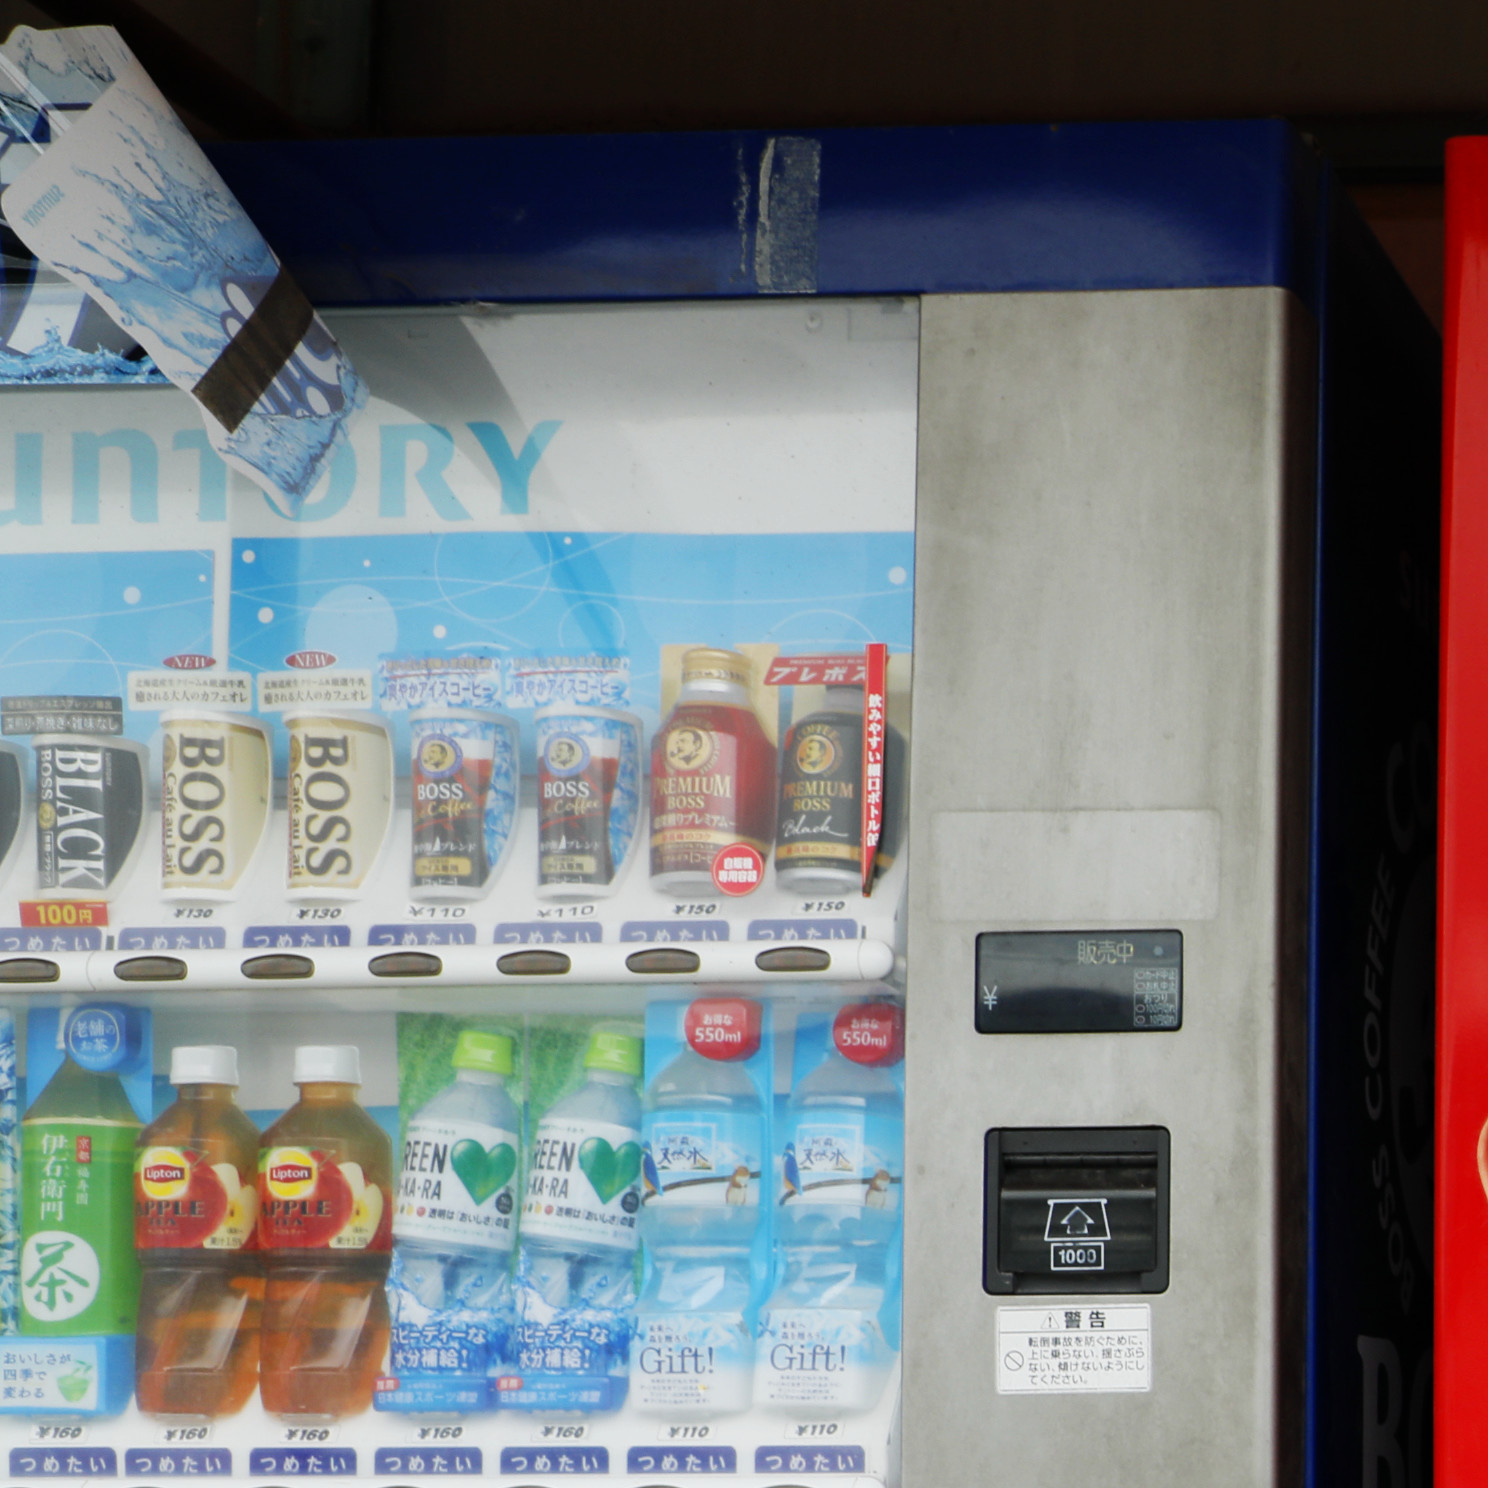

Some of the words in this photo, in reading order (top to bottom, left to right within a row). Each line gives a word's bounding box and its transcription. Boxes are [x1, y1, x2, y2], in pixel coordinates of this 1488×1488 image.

[417, 783, 463, 800] BOSS
[179, 734, 225, 876] BOSS
[304, 734, 352, 876] BOSS
[55, 748, 106, 889] BLACK
[36, 904, 93, 925] 100円
[1077, 940, 1134, 964] 販売中
[695, 1026, 741, 1043] 550ml
[842, 1032, 887, 1048] 550ml
[41, 1133, 66, 1221] 伊右衛門
[146, 1168, 181, 1181] Lipton
[272, 1168, 308, 1181] Lipton
[1058, 1249, 1097, 1264] 1000
[25, 1241, 90, 1312] 茶
[1064, 1311, 1106, 1328] 警告
[3, 1353, 72, 1366] おいしさが
[639, 1346, 714, 1374] Gift!
[770, 1344, 846, 1372] Gift!
[3, 1369, 48, 1382] 四季で
[1029, 1374, 1088, 1385] てください。
[3, 1386, 45, 1399] 変わる
[20, 1456, 107, 1473] つめたい
[135, 1456, 222, 1473] つめたい
[260, 1456, 347, 1472] つめたい
[385, 1456, 472, 1472] つめたい
[511, 1456, 598, 1472] つめたい
[639, 1456, 726, 1471] つめたい
